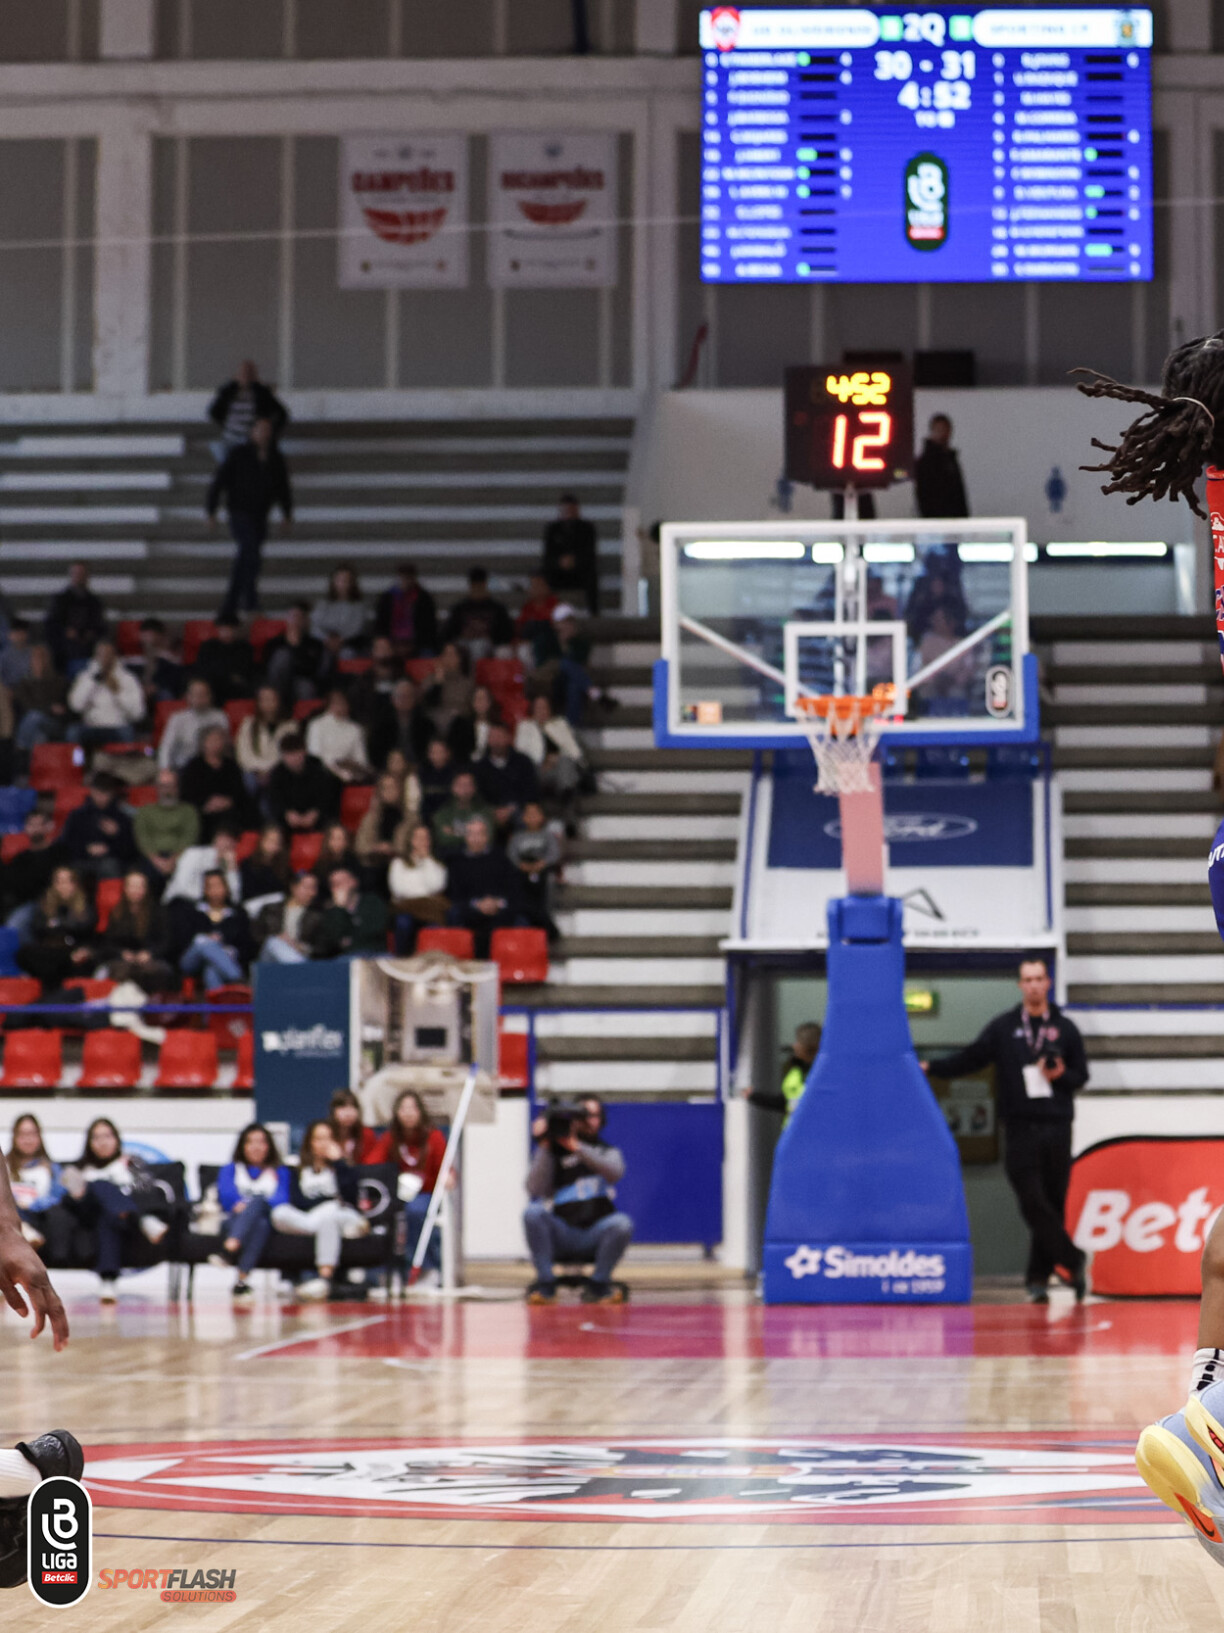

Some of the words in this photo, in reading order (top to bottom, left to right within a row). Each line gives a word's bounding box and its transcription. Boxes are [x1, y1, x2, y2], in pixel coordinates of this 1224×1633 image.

[902, 13, 946, 47] 2Q
[940, 51, 976, 80] 31
[833, 412, 891, 469] 12
[823, 1245, 945, 1278] Simoldes
